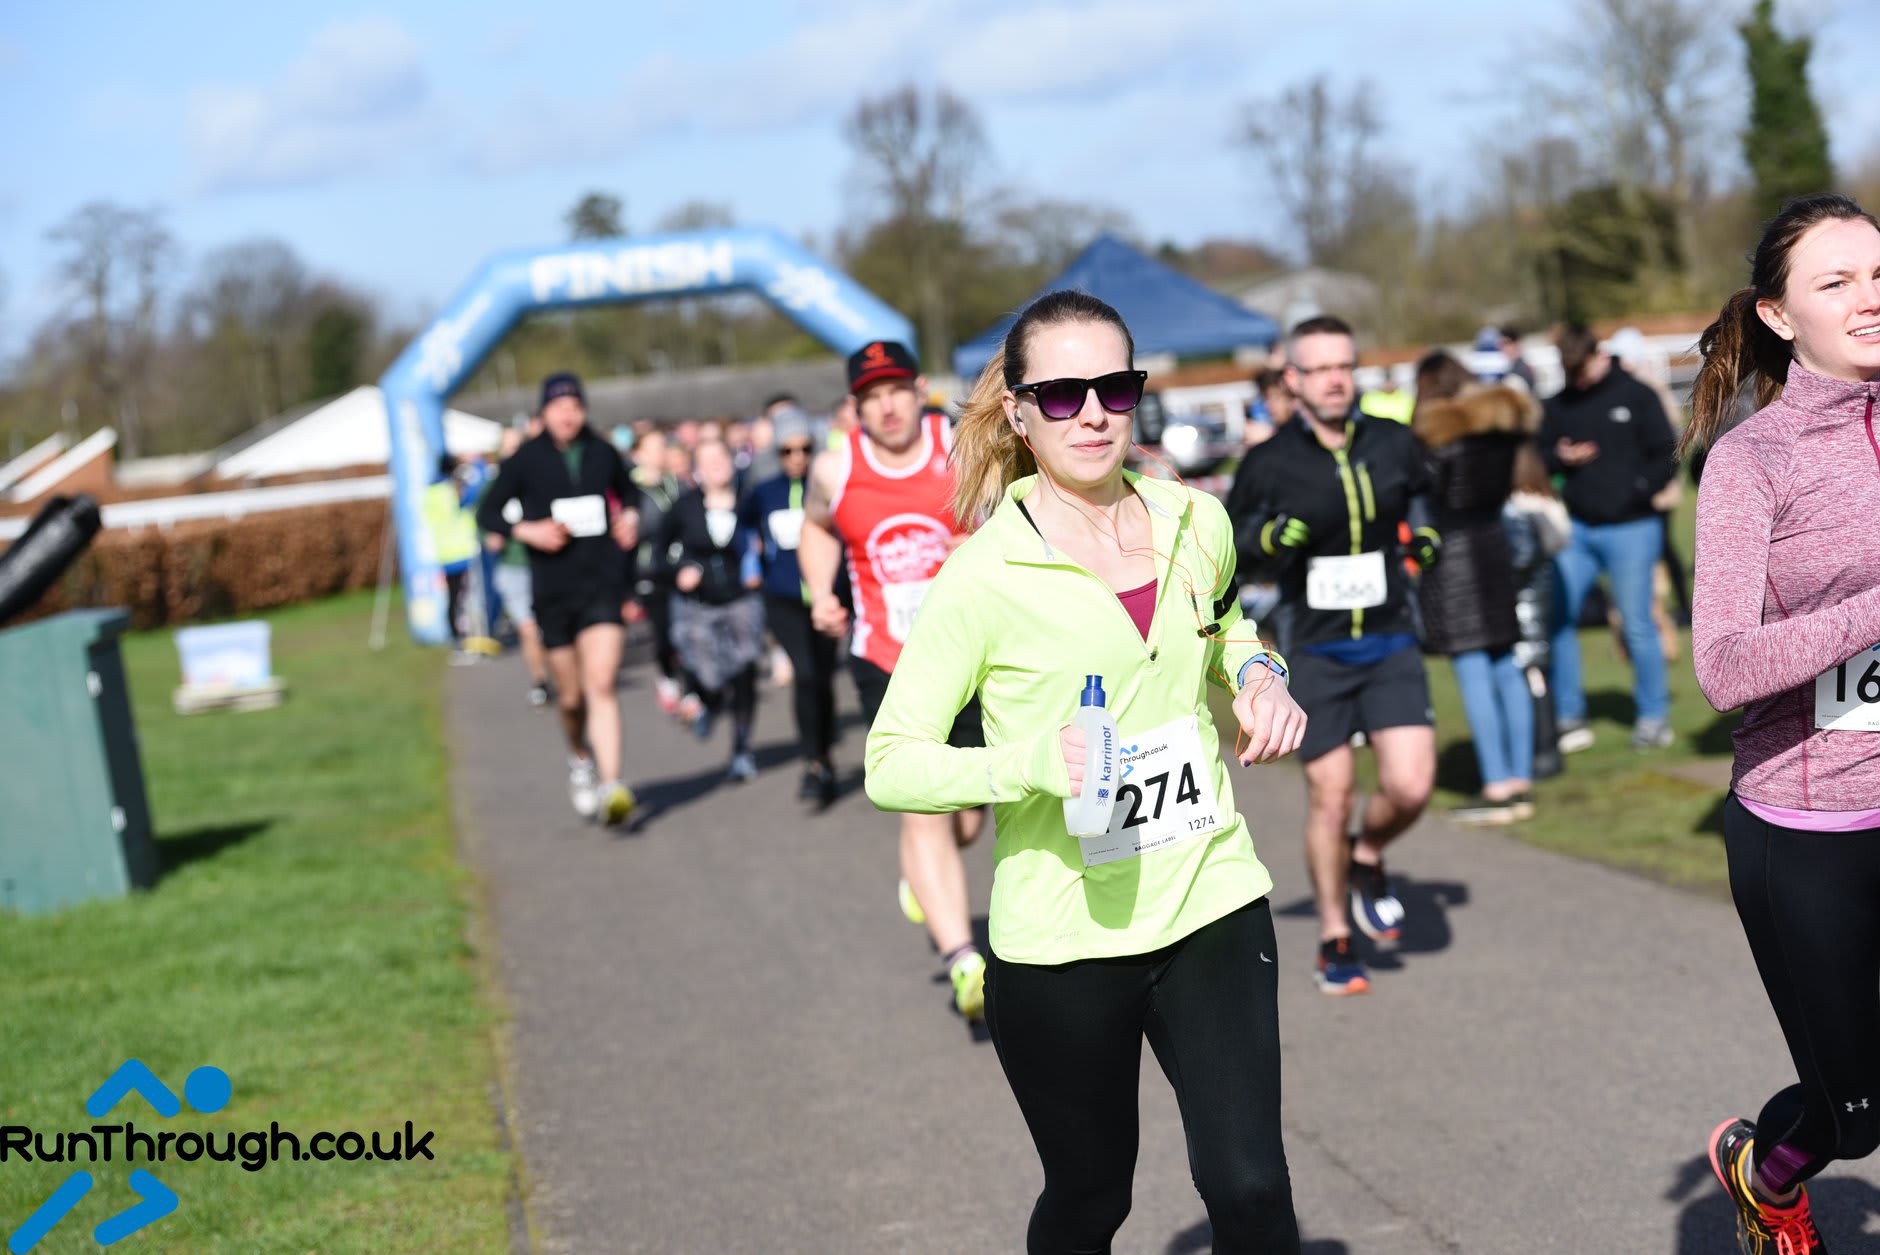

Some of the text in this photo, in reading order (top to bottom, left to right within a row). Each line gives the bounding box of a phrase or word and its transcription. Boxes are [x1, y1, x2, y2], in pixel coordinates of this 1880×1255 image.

[530, 239, 733, 303] FINISH
[1101, 725, 1112, 782] karrimor
[1106, 761, 1201, 834] 274
[1188, 815, 1215, 831] 1274
[1134, 839, 1161, 852] BAGGAGE
[1161, 835, 1176, 844] LABEL
